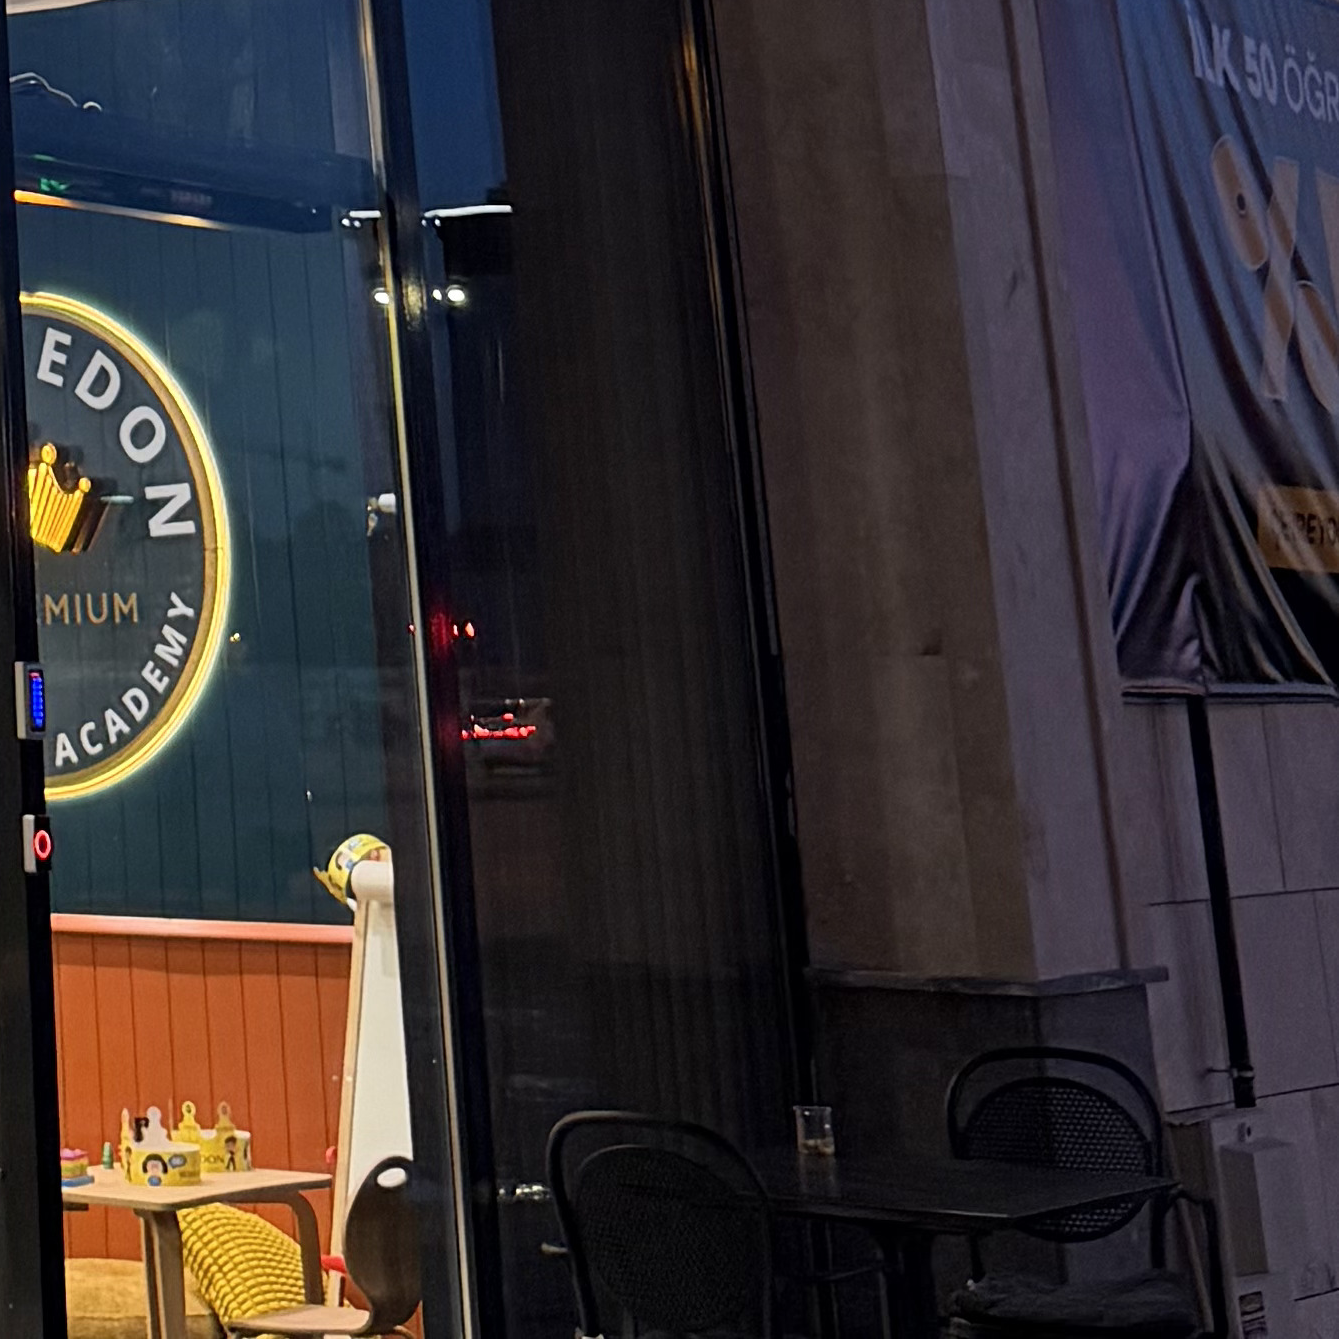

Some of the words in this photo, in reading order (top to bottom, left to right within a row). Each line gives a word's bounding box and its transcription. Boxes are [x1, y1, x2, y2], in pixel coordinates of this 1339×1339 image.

[1242, 34, 1278, 106] 50
[43, 591, 139, 627] MIUM
[53, 590, 196, 768] ACADEMY
